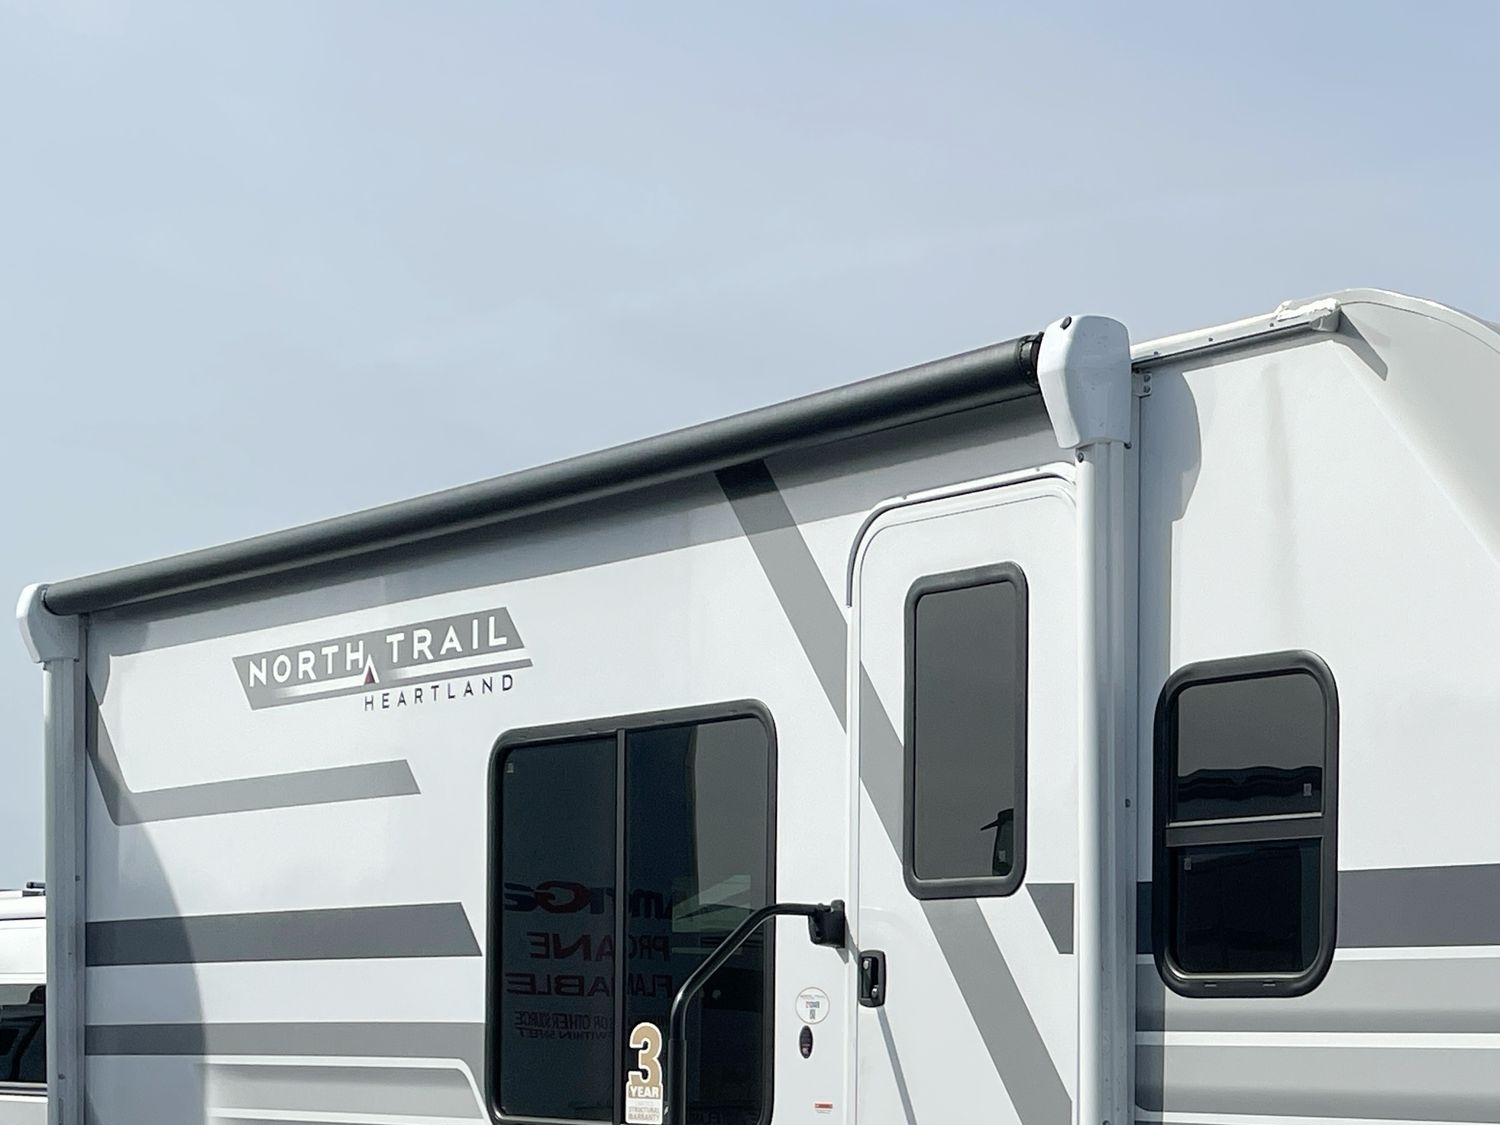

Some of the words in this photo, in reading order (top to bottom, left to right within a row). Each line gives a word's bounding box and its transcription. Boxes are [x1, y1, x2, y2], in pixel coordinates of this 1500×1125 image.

[249, 640, 364, 687] NORTH
[386, 616, 507, 663] TRAIL
[365, 674, 514, 711] HEARTLAND
[629, 1022, 663, 1087] 3
[630, 1086, 660, 1098] YEAR
